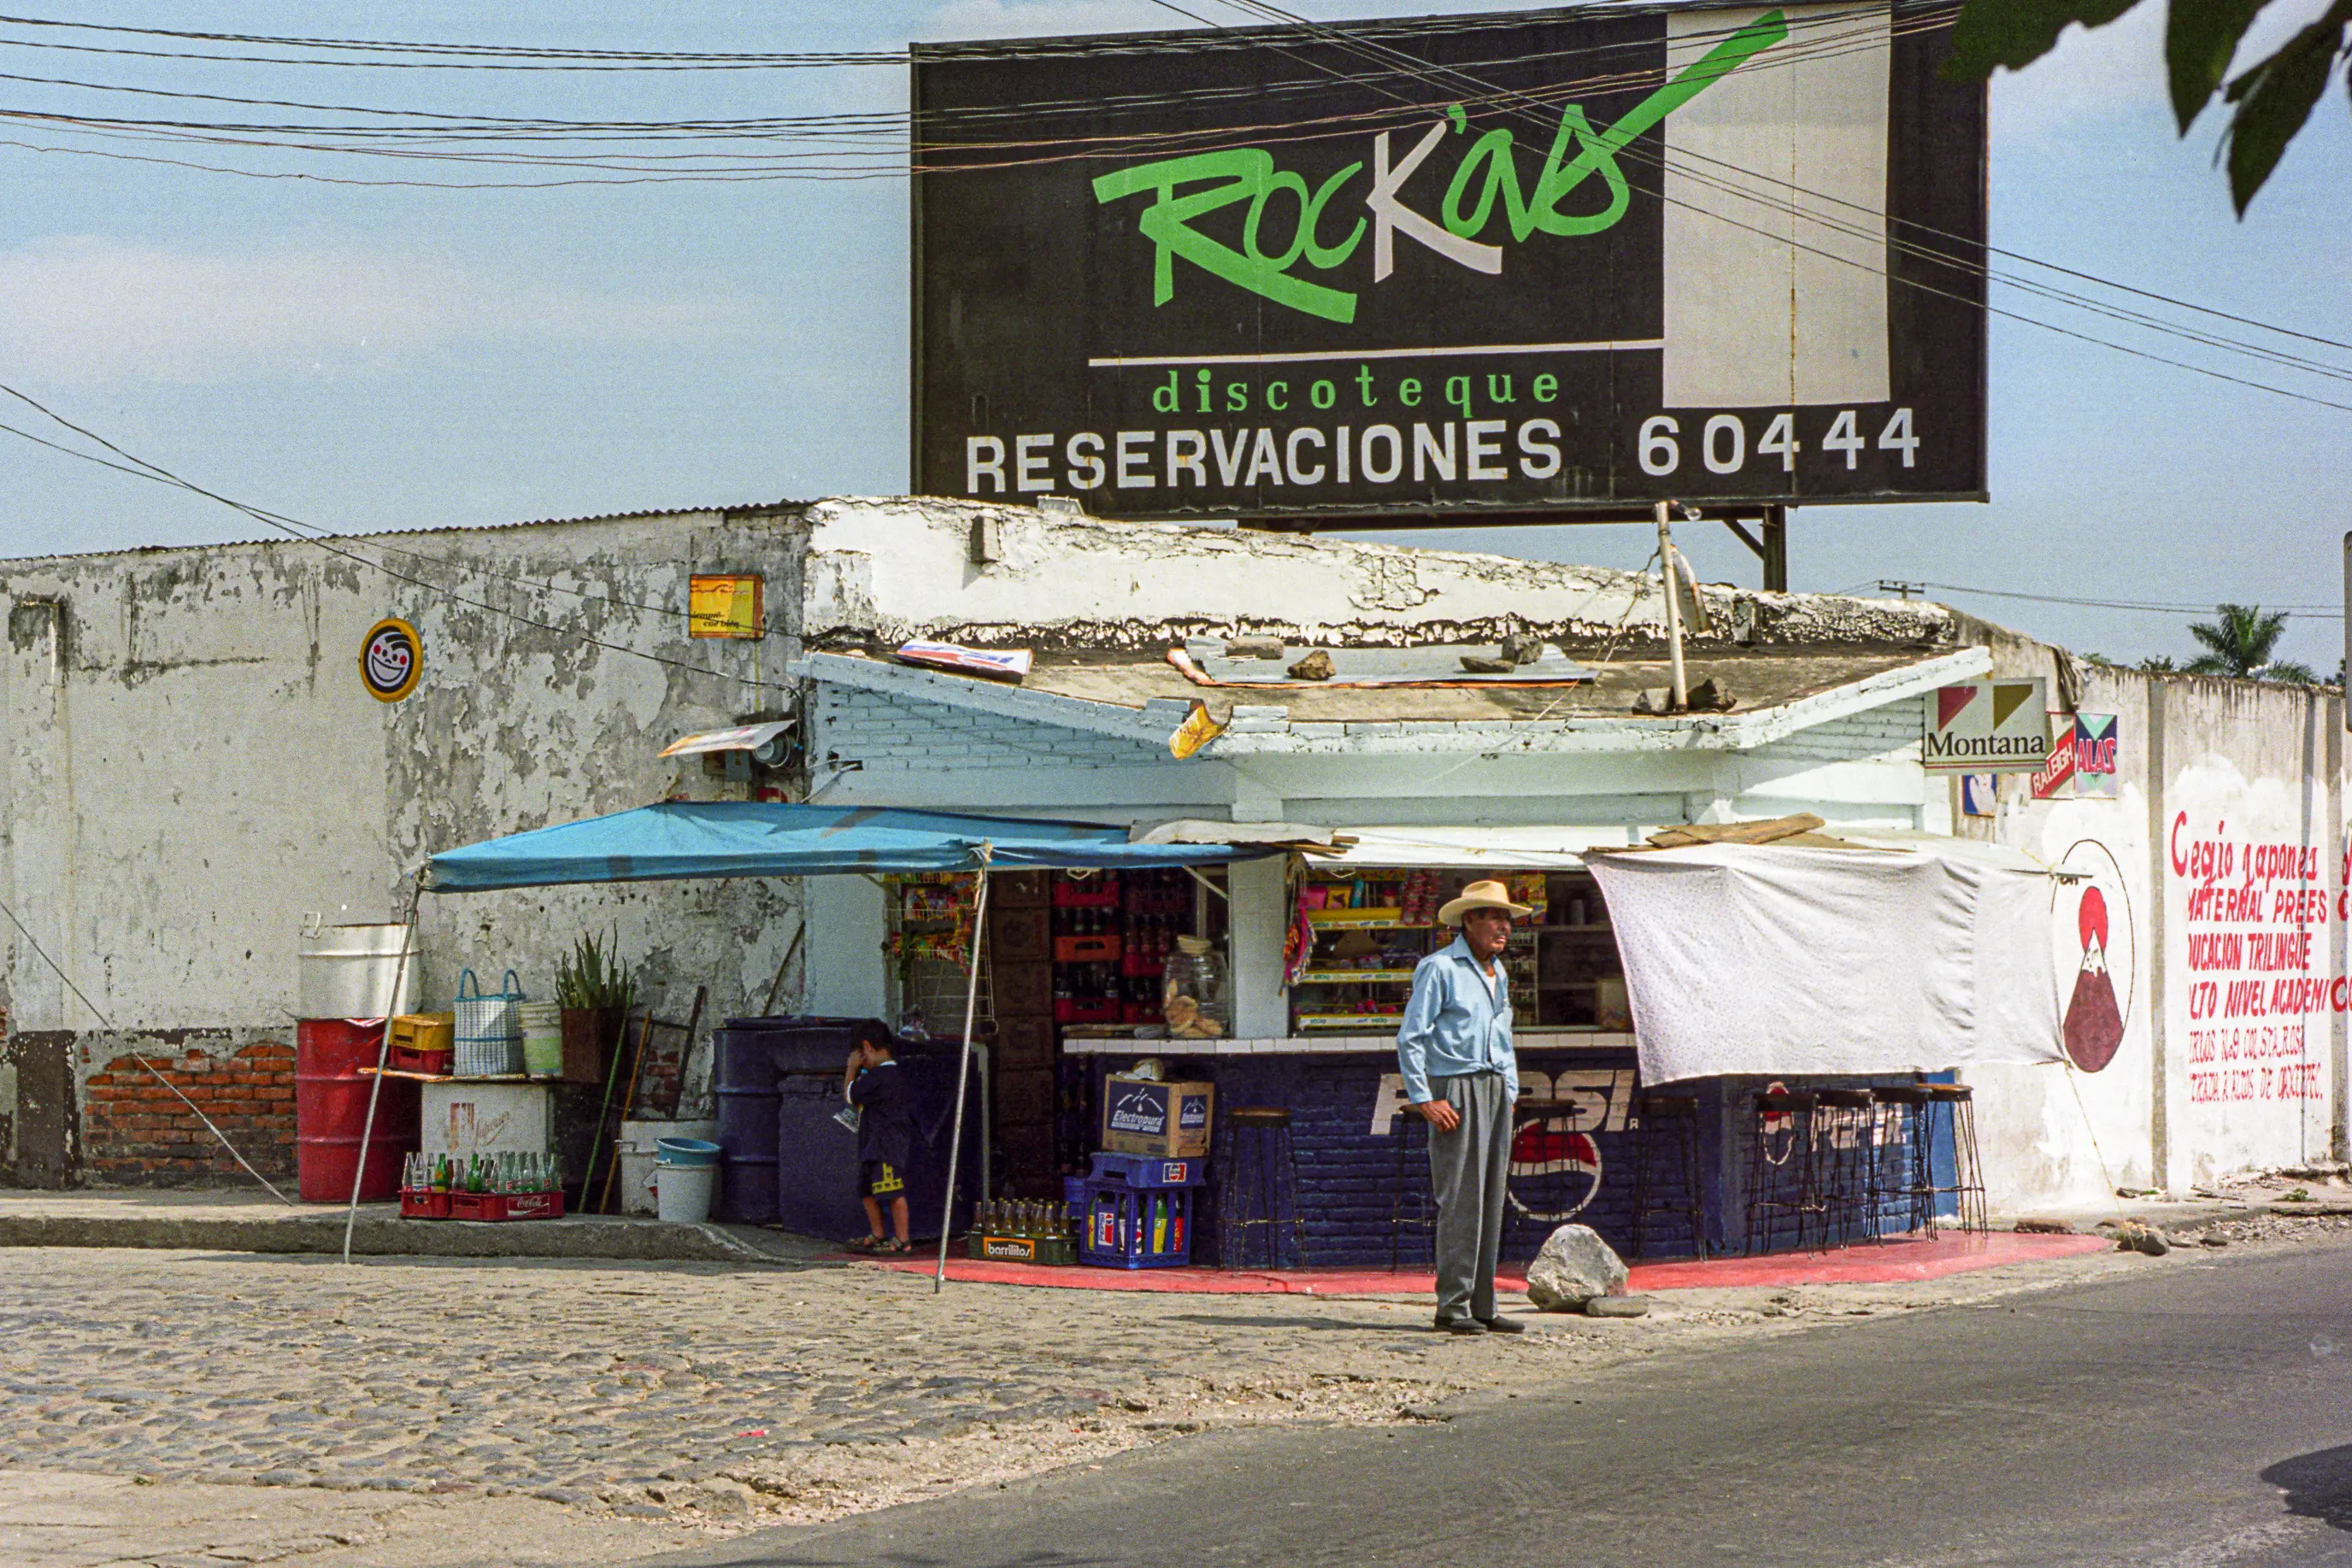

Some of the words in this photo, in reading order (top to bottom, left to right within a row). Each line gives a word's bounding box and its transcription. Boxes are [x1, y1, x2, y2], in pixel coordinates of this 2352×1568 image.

[1151, 362, 1560, 419] discoteque
[966, 418, 1562, 495] RESERVACIONES
[1638, 407, 1921, 479] 60444
[1926, 731, 2045, 757] Montana
[2076, 737, 2117, 775] ALAS
[2032, 743, 2074, 796] RALEIGH
[2189, 981, 2218, 1019] LTO
[2224, 979, 2267, 1019] NIVEL
[1114, 1110, 1163, 1127] Electropura
[1370, 1069, 1636, 1135] PPSI
[988, 1243, 1031, 1257] barrilitos
